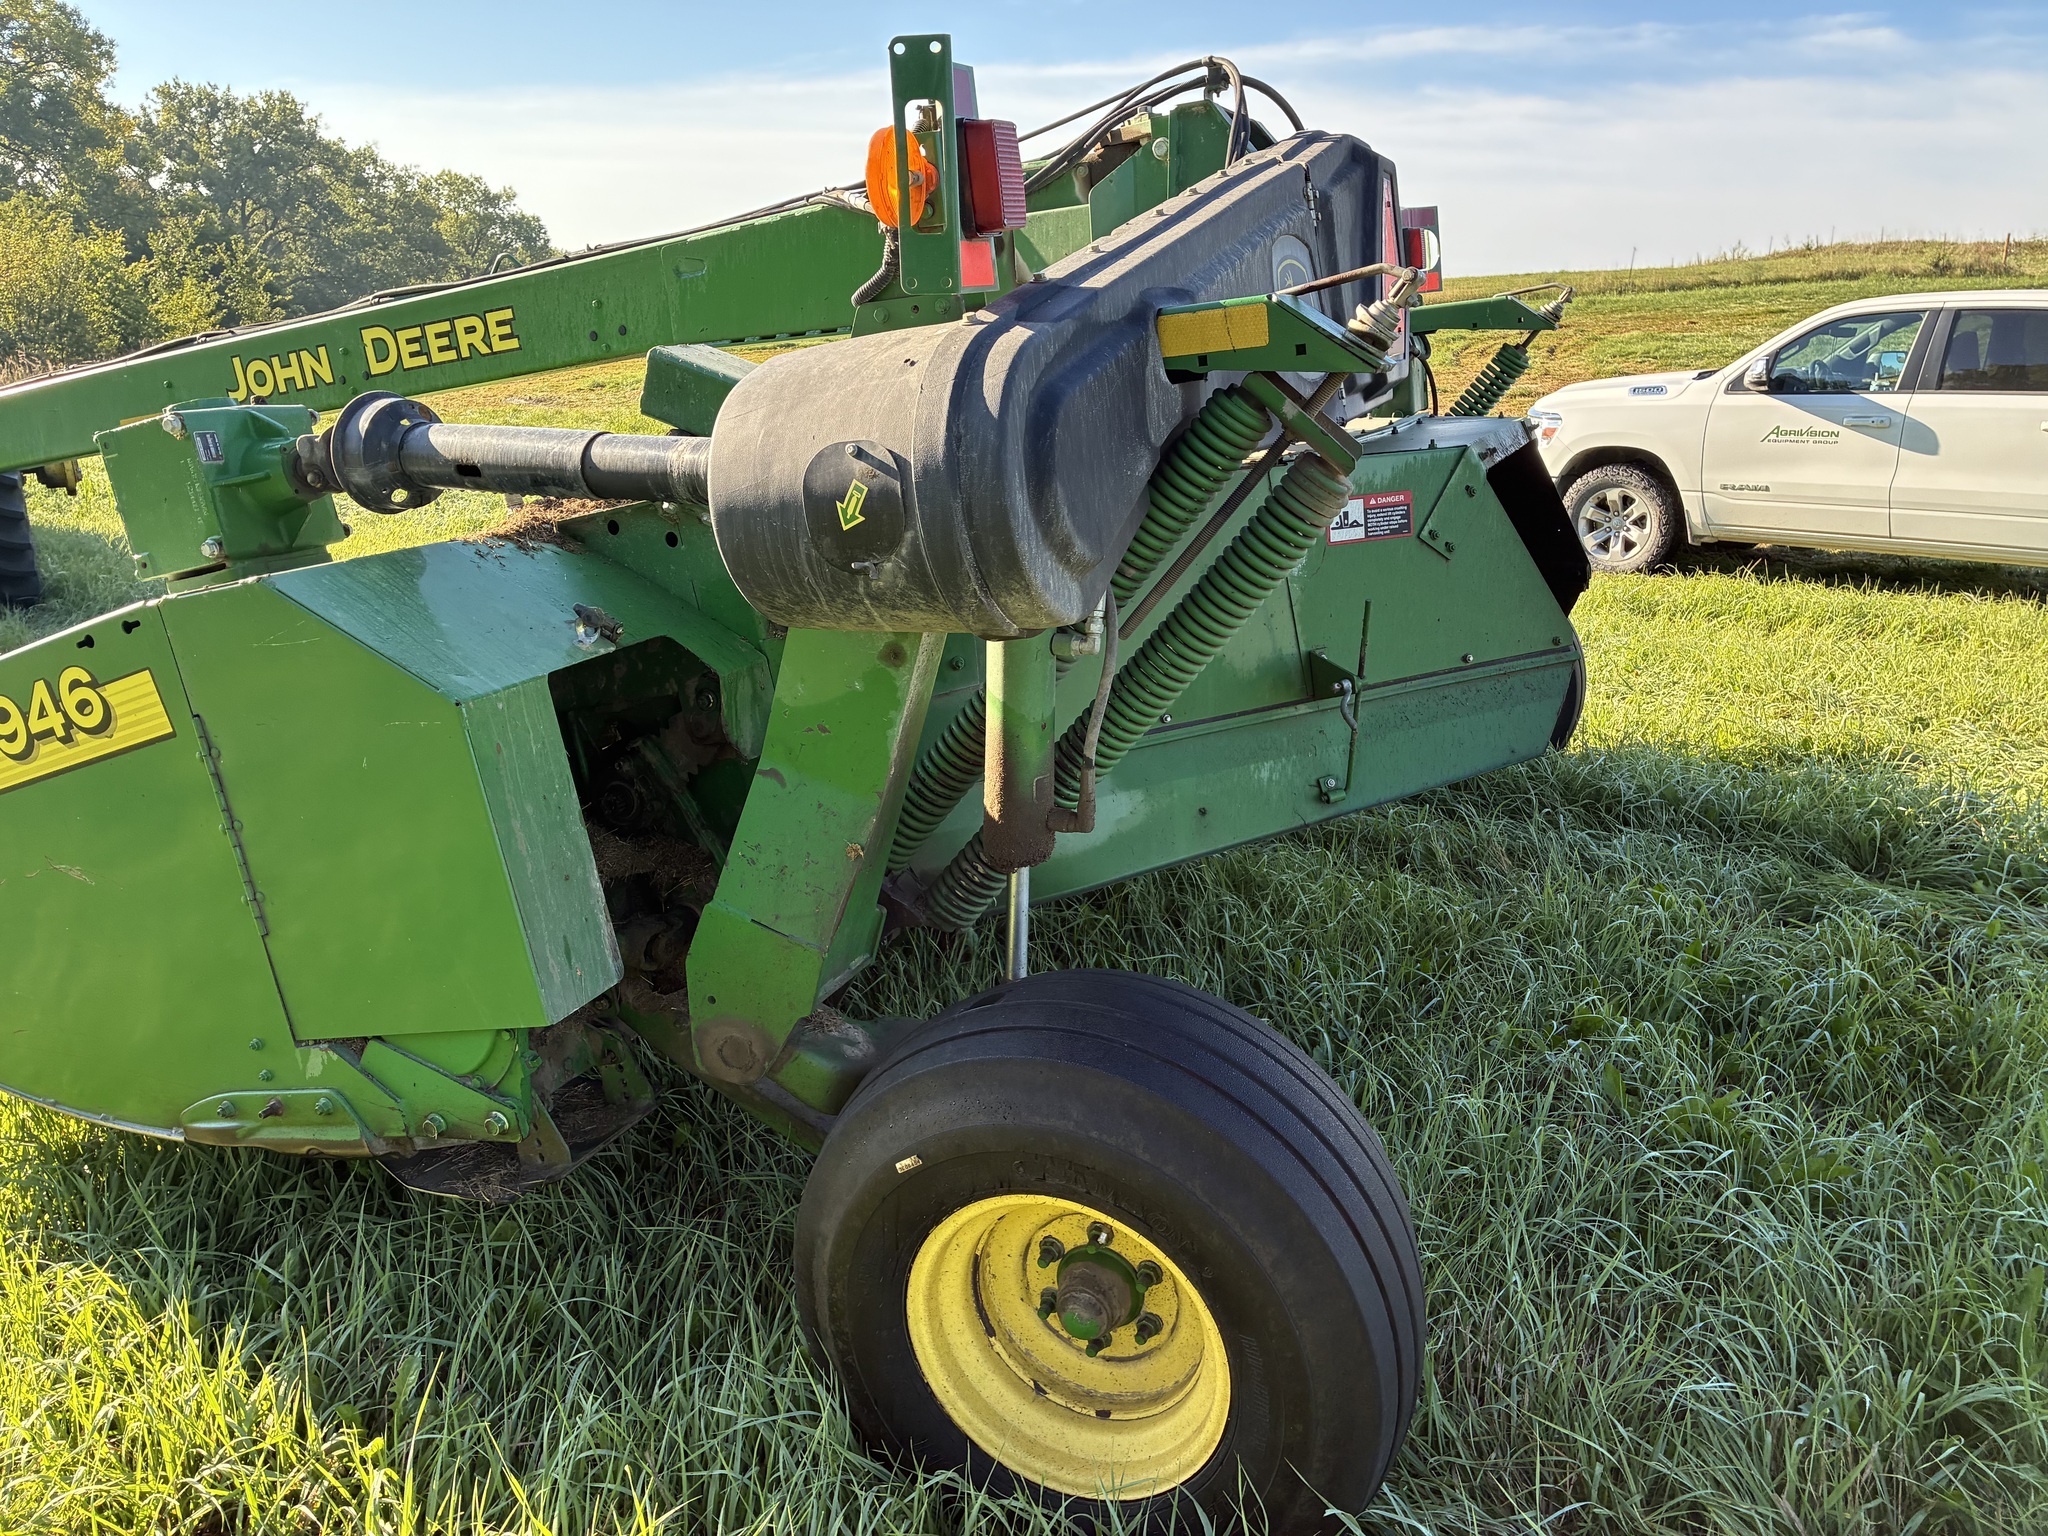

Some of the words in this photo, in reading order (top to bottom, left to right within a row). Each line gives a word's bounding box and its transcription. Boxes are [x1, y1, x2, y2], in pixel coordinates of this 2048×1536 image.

[226, 344, 334, 402] JOHN
[360, 306, 522, 377] DEERE
[1760, 425, 1840, 442] AGRIVISION
[1377, 495, 1404, 504] DANGER
[0, 665, 112, 762] 946
